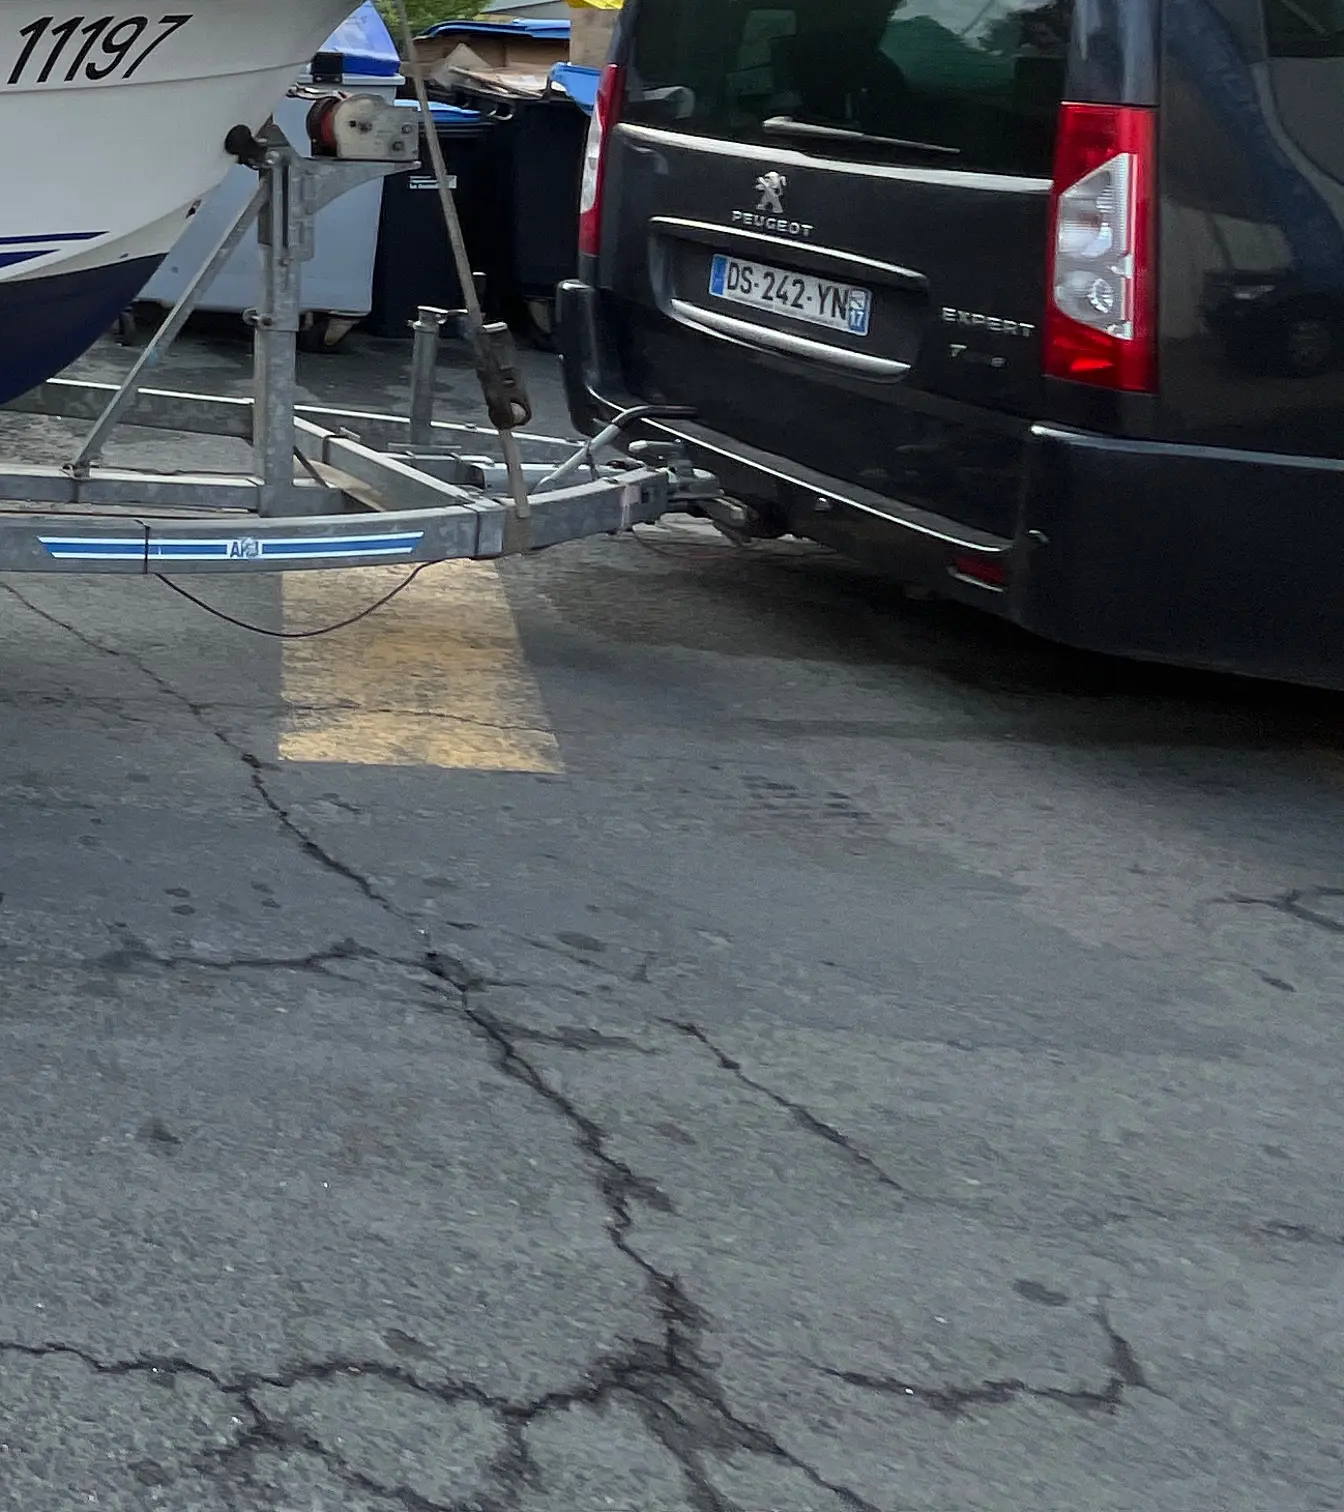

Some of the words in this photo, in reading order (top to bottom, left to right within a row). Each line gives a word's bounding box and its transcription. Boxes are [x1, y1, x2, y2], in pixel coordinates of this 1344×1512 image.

[6, 13, 194, 85] 11197
[731, 210, 814, 237] PEUGEOT
[727, 261, 849, 321] DS-242-YN
[849, 309, 865, 327] 17
[942, 306, 1036, 337] EXPERT
